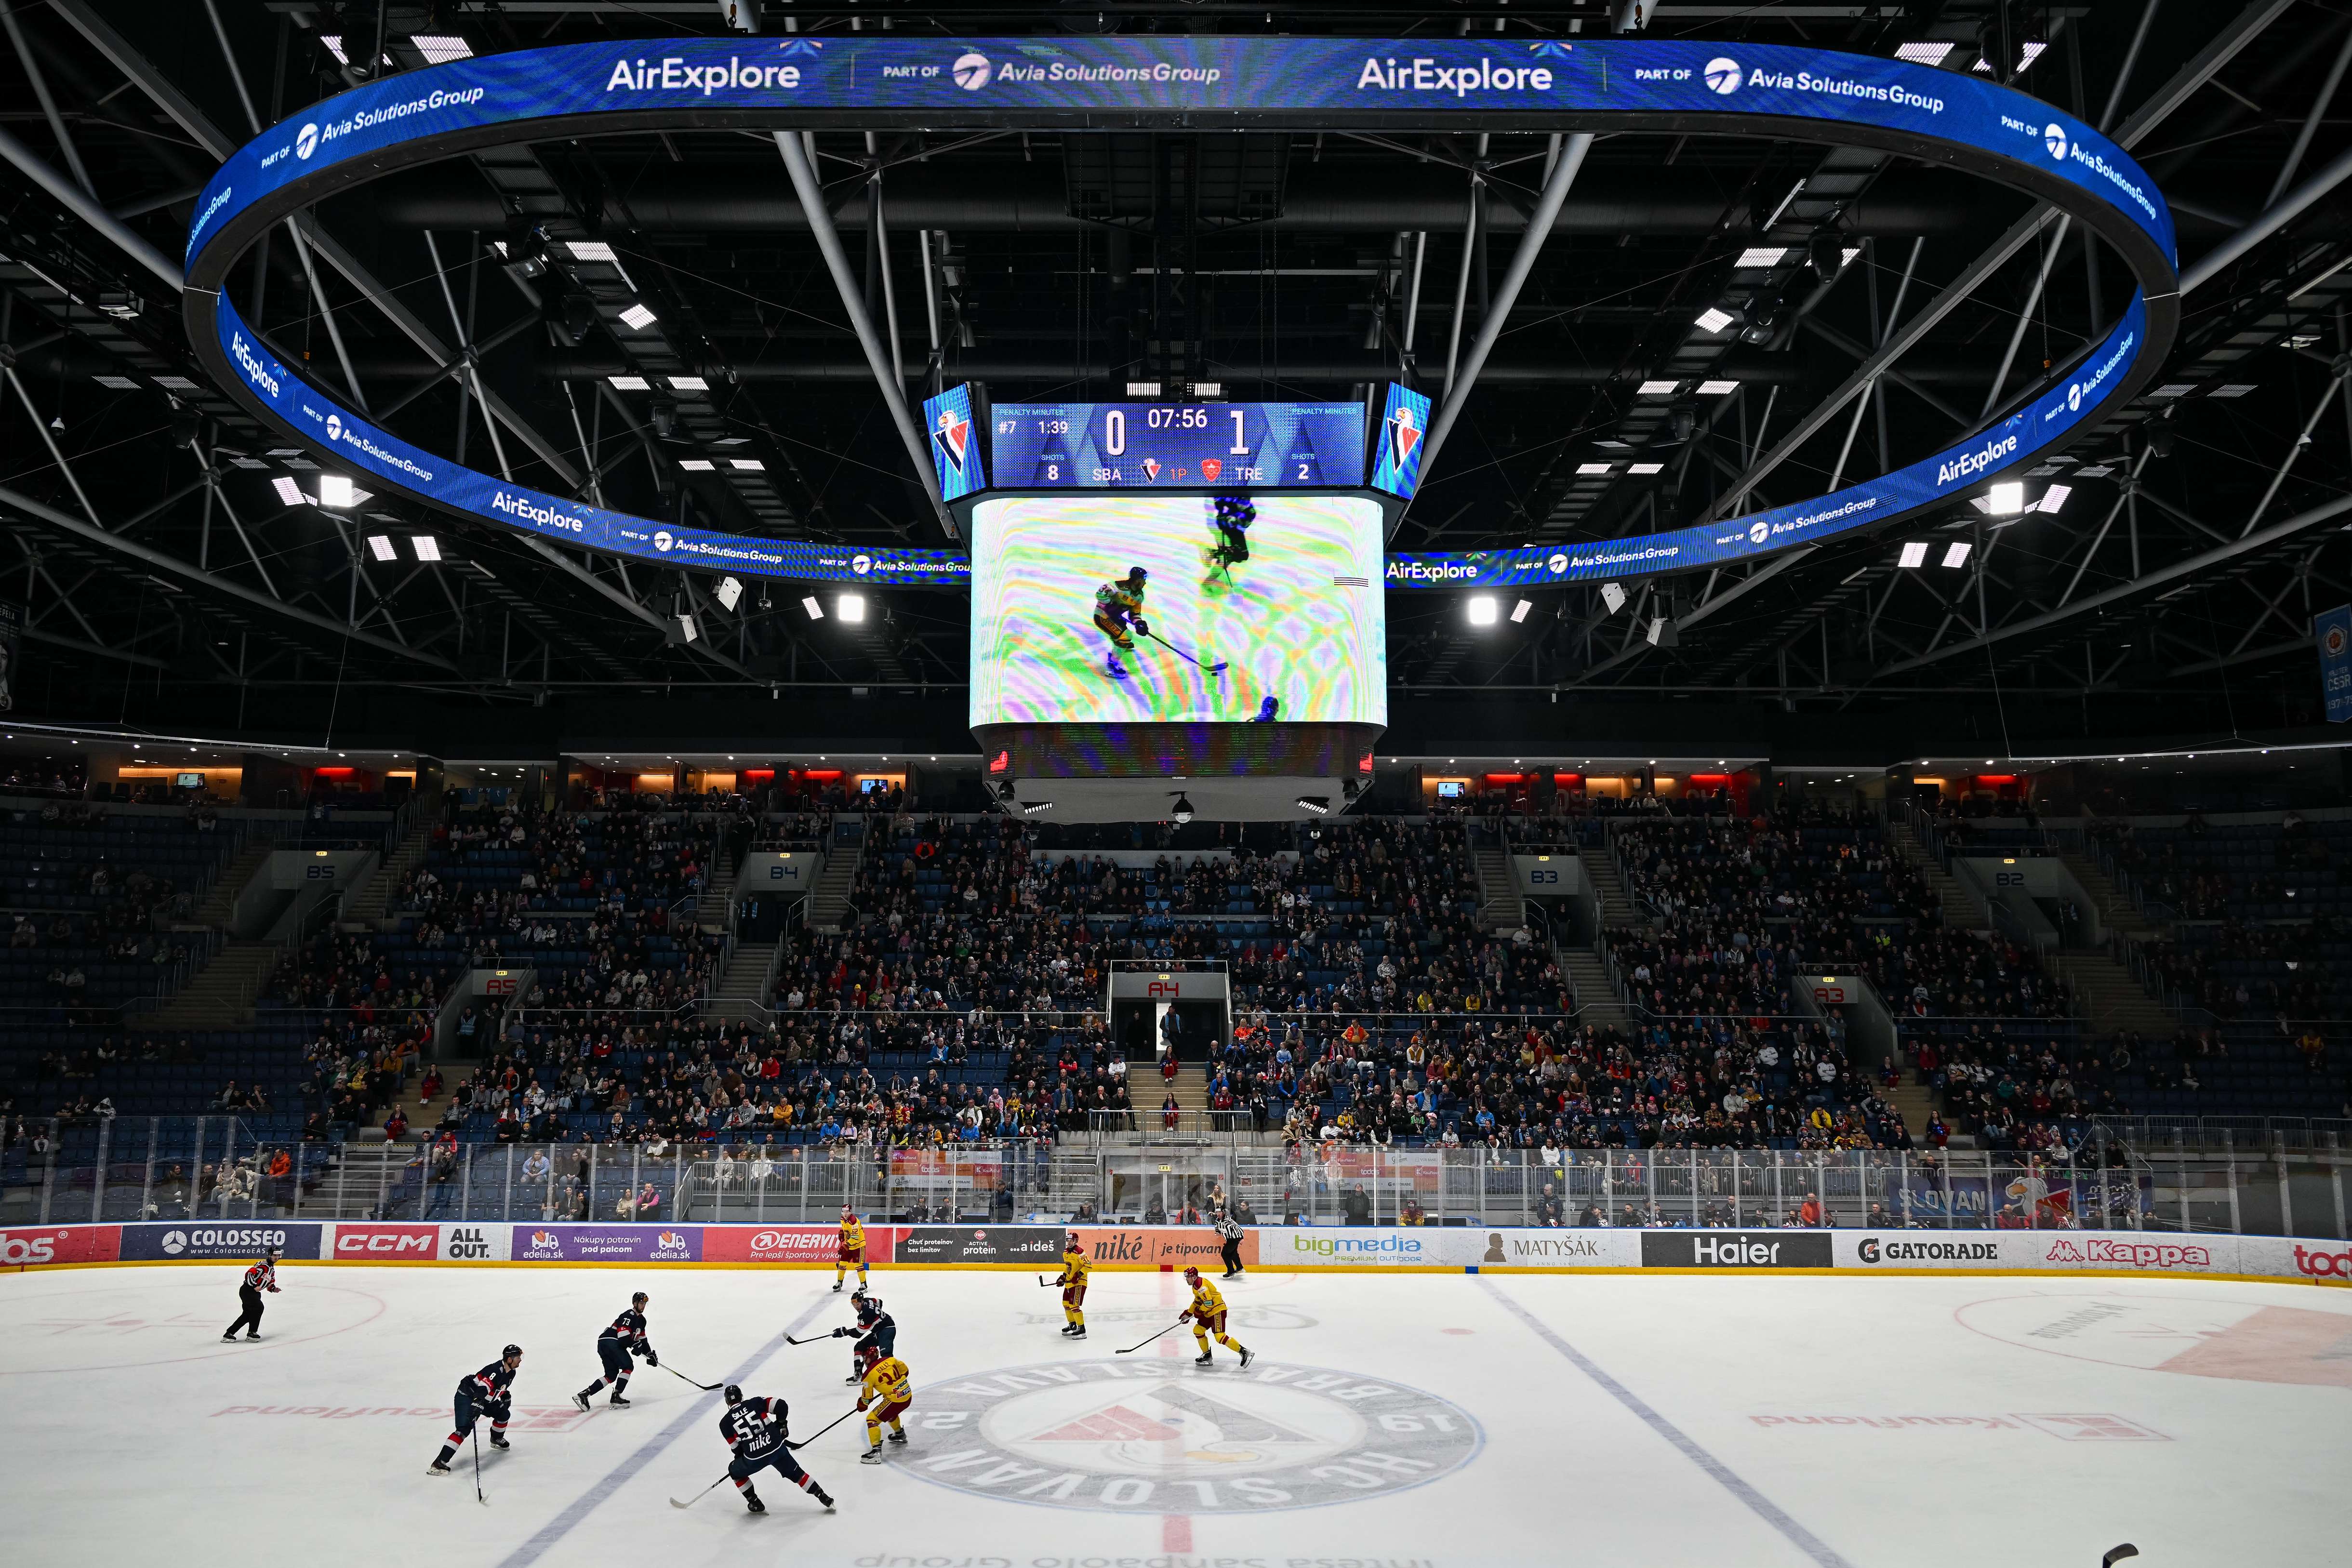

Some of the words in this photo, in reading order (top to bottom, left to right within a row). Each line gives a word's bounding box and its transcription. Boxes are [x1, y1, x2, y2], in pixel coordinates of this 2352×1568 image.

[606, 56, 800, 96] AirExplore
[883, 65, 918, 78] PART
[921, 65, 941, 78] OF
[997, 63, 1045, 82] Avia
[1048, 63, 1151, 82] Solutions
[1153, 63, 1221, 85] Group
[1357, 57, 1552, 97] AirExplore
[1635, 69, 1670, 80] PART
[1673, 69, 1692, 80] OF
[1748, 68, 1794, 89] Avia
[1796, 72, 1888, 102] Solutions
[1888, 84, 1944, 114] Group
[261, 152, 279, 169] PART
[279, 146, 291, 159] OF
[321, 120, 352, 143] Avia
[353, 98, 428, 131] Solutions
[428, 87, 484, 109] Group
[2001, 116, 2025, 133] PART
[2025, 126, 2039, 137] OF
[2070, 142, 2096, 169] Avia
[2095, 158, 2138, 199] Solutions
[2136, 186, 2157, 220] Group
[211, 186, 231, 214] Group
[232, 331, 279, 398] AirExplore
[2082, 377, 2097, 397] Avia
[2095, 353, 2122, 384] Solutions
[998, 420, 1016, 435] #7
[1038, 420, 1069, 435] 1:39
[1148, 409, 1208, 429] 07:56
[1106, 410, 1126, 456] 0
[1230, 410, 1249, 455] 1
[303, 404, 317, 420] PART
[316, 413, 324, 423] OF
[342, 428, 362, 449] Avia
[361, 439, 404, 471] Solutions
[403, 459, 433, 482] Group
[1937, 434, 2018, 486] AirExplore
[1048, 464, 1059, 481] 8
[1092, 467, 1122, 481] SBA
[1169, 468, 1187, 480] 1P
[1235, 467, 1263, 481] TRE
[1299, 464, 1310, 480] 2
[492, 491, 584, 532] AirExplore
[1716, 535, 1734, 545] PART
[1734, 532, 1745, 543] OF
[1771, 520, 1795, 536] Avia
[1795, 506, 1845, 529] Solutions
[1844, 496, 1877, 515] Group
[621, 530, 638, 540] PART
[675, 539, 699, 553] Avia
[699, 544, 750, 560] Solutions
[749, 549, 782, 564] Group
[819, 558, 836, 566] PART
[873, 560, 897, 571] Avia
[897, 561, 945, 572] Solutions
[1570, 556, 1594, 568] Avia
[1594, 552, 1646, 565] Solutions
[1645, 546, 1679, 560] Group
[1385, 561, 1478, 582] AirExplore
[306, 865, 335, 878] B5
[770, 866, 798, 880] B4
[1531, 870, 1558, 883] B3
[1996, 873, 2024, 886] B2
[486, 979, 518, 994] A5
[1148, 982, 1179, 997] A4
[1814, 988, 1844, 1003] A3
[1899, 1189, 1986, 1211] SLOVAN
[191, 1229, 286, 1246] COLOSSEO
[337, 1234, 433, 1251] CCM
[450, 1228, 484, 1242] ALL
[573, 1236, 605, 1245] Nákupy
[607, 1236, 641, 1245] potravín
[778, 1234, 840, 1248] ENERVIT
[449, 1244, 490, 1259] OUT.
[582, 1246, 598, 1254] pod
[600, 1245, 632, 1254] palcom
[963, 1245, 997, 1256] protein
[1030, 1239, 1054, 1252] ideš
[1094, 1233, 1143, 1261] niké
[1161, 1243, 1173, 1257] je
[1175, 1243, 1226, 1257] tipovani
[1294, 1234, 1422, 1256] bigmedia
[1513, 1235, 1599, 1256] MATYŠÁK
[1694, 1236, 1781, 1264] Haier
[1886, 1243, 1998, 1260] GATORADE
[2087, 1239, 2210, 1267] Kappa
[523, 1249, 564, 1259] edelia.sk
[650, 1249, 691, 1259] edelia.sk
[765, 1250, 784, 1260] lepší
[785, 1250, 820, 1260] športový
[821, 1251, 842, 1261] výko
[623, 1317, 631, 1326] 73
[490, 1371, 497, 1381] 8
[941, 1359, 1398, 1400] BRATISLAVA
[732, 1410, 765, 1441] 55
[1377, 1414, 1459, 1432] 19
[1748, 1415, 2021, 1429] Kaufland
[749, 1431, 771, 1452] niké
[917, 1448, 1293, 1507] SLOVAN
[1311, 1451, 1437, 1489] HC
[853, 1553, 1012, 1568] Group
[1032, 1555, 1267, 1568] Sanpaolo
[1287, 1557, 1433, 1568] Intesa
